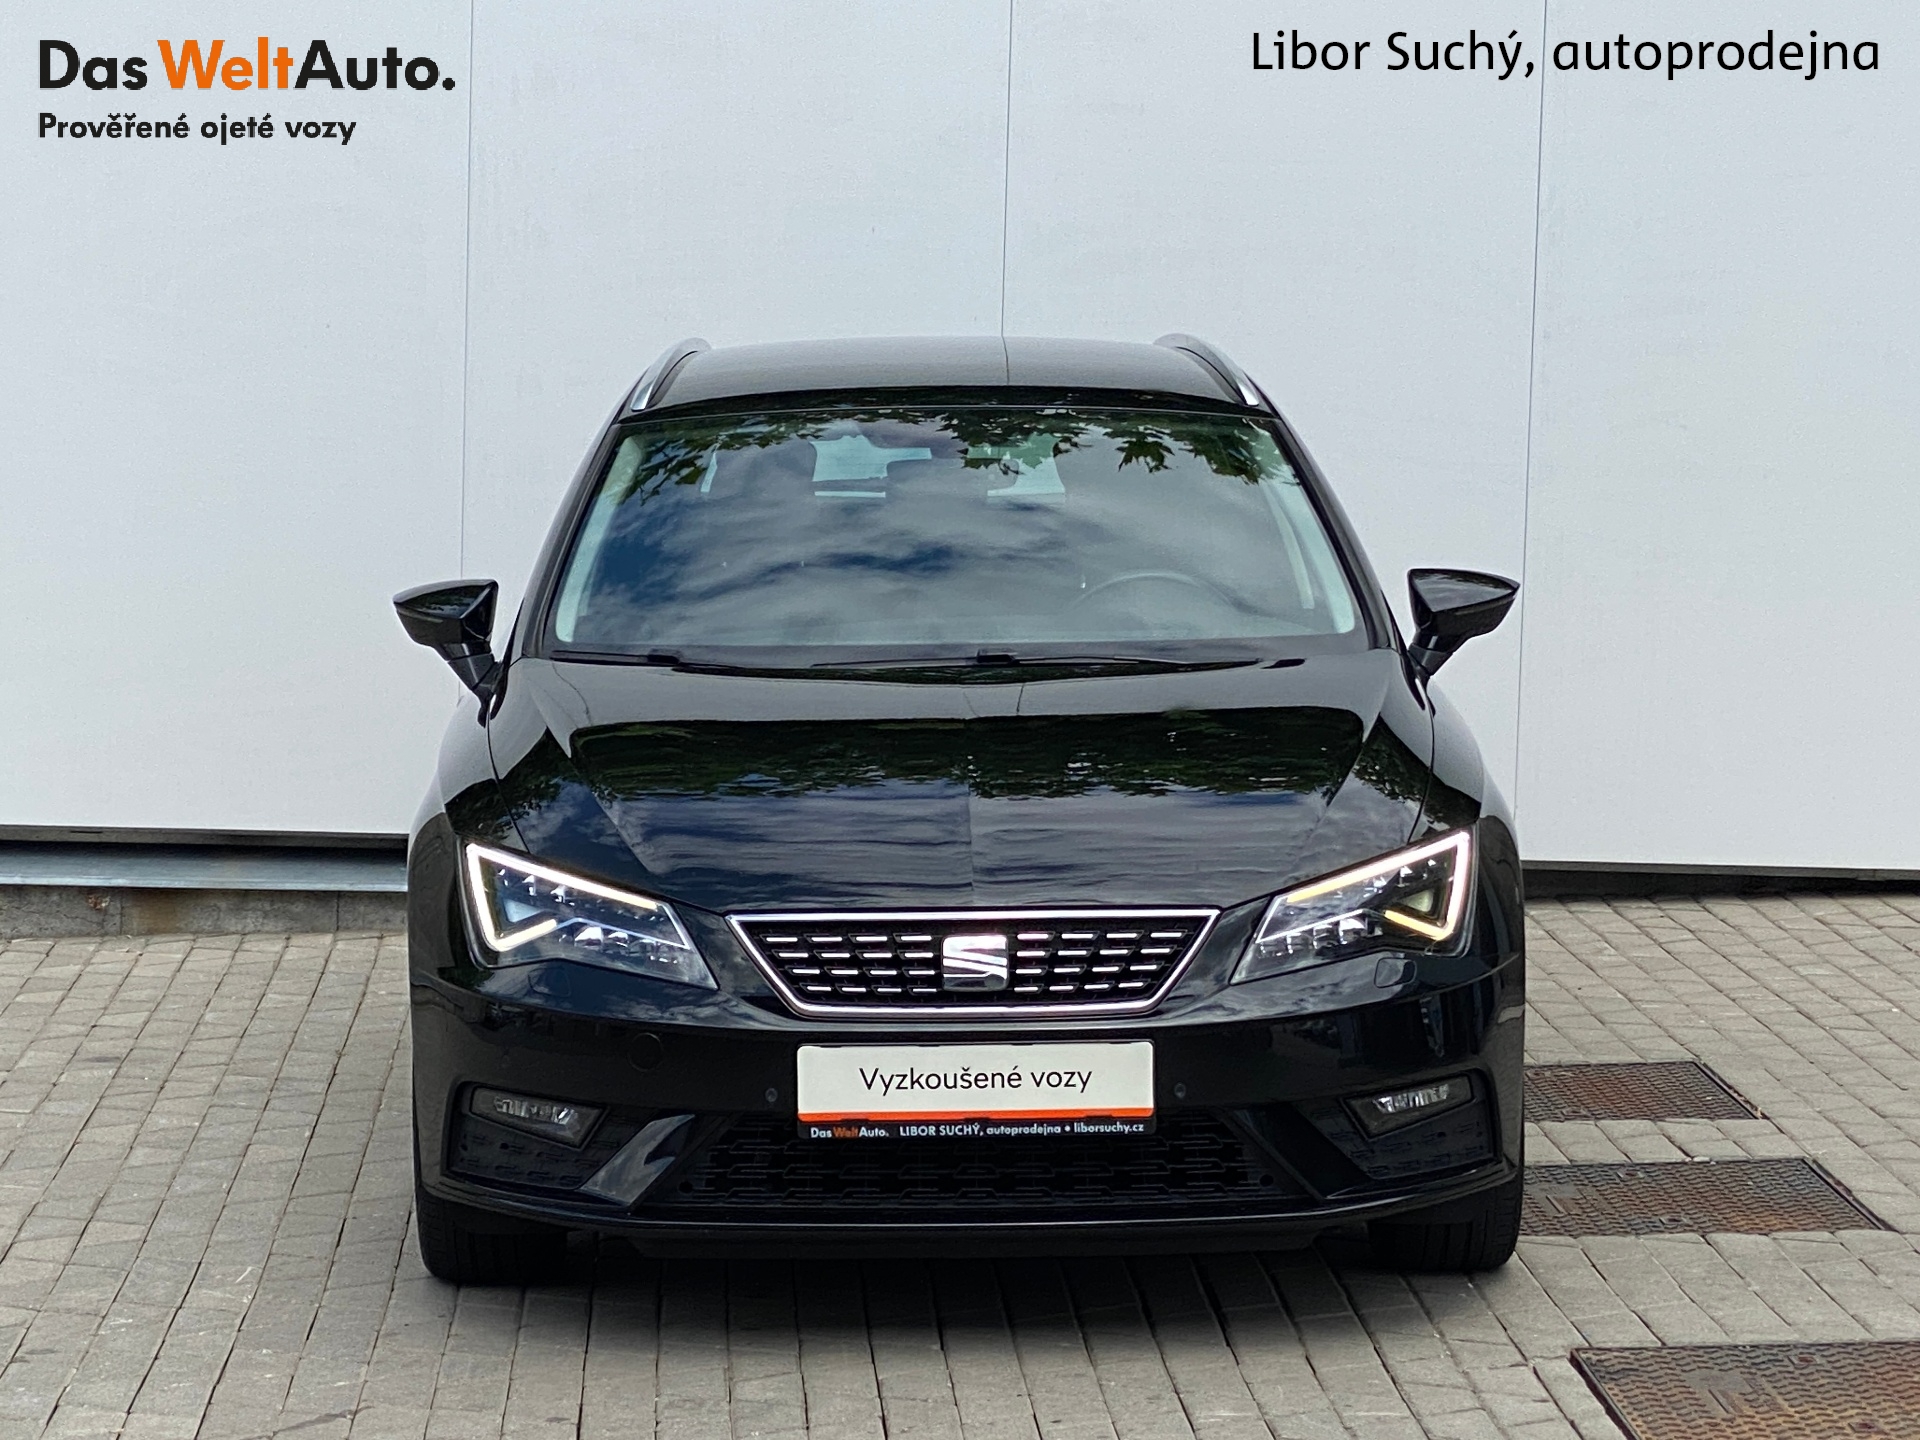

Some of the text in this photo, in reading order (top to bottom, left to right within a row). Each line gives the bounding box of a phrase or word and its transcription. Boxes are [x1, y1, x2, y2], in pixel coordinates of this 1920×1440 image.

[859, 1066, 1093, 1097] Vyzkoušené vozy
[899, 1125, 937, 1137] LIBOR
[939, 1122, 984, 1137] SUCHÝ,
[986, 1123, 1062, 1137] autoprodejna
[1073, 1121, 1144, 1135] liborsuchy.cz
